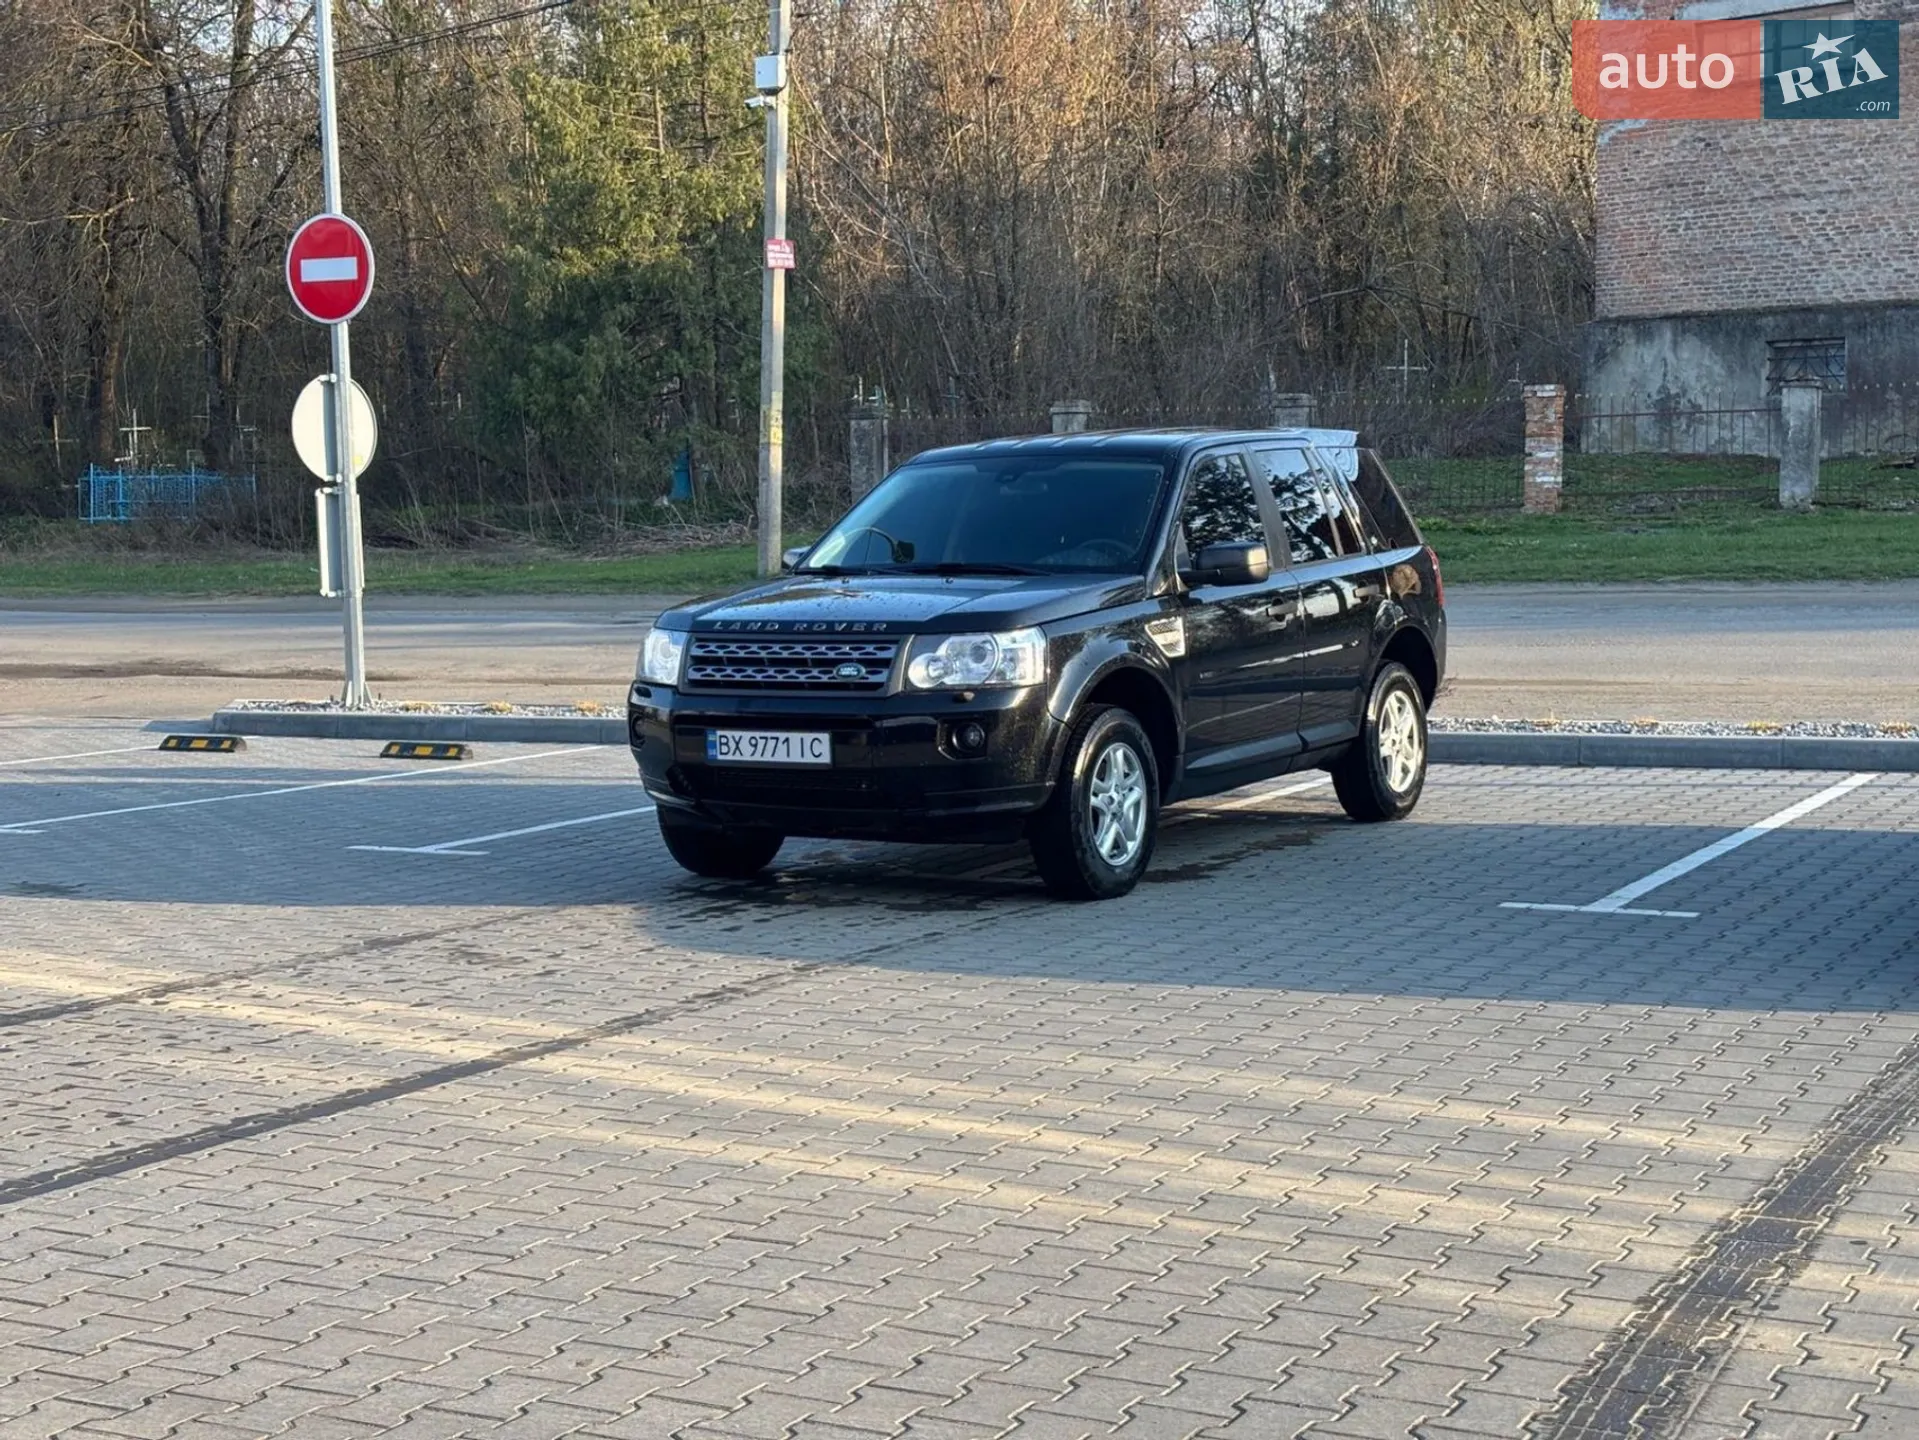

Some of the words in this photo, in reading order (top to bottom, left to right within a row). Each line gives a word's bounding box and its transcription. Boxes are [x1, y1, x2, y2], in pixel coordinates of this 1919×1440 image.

[713, 621, 779, 631] LAND
[793, 622, 887, 632] ROVER
[748, 736, 790, 758] 9771
